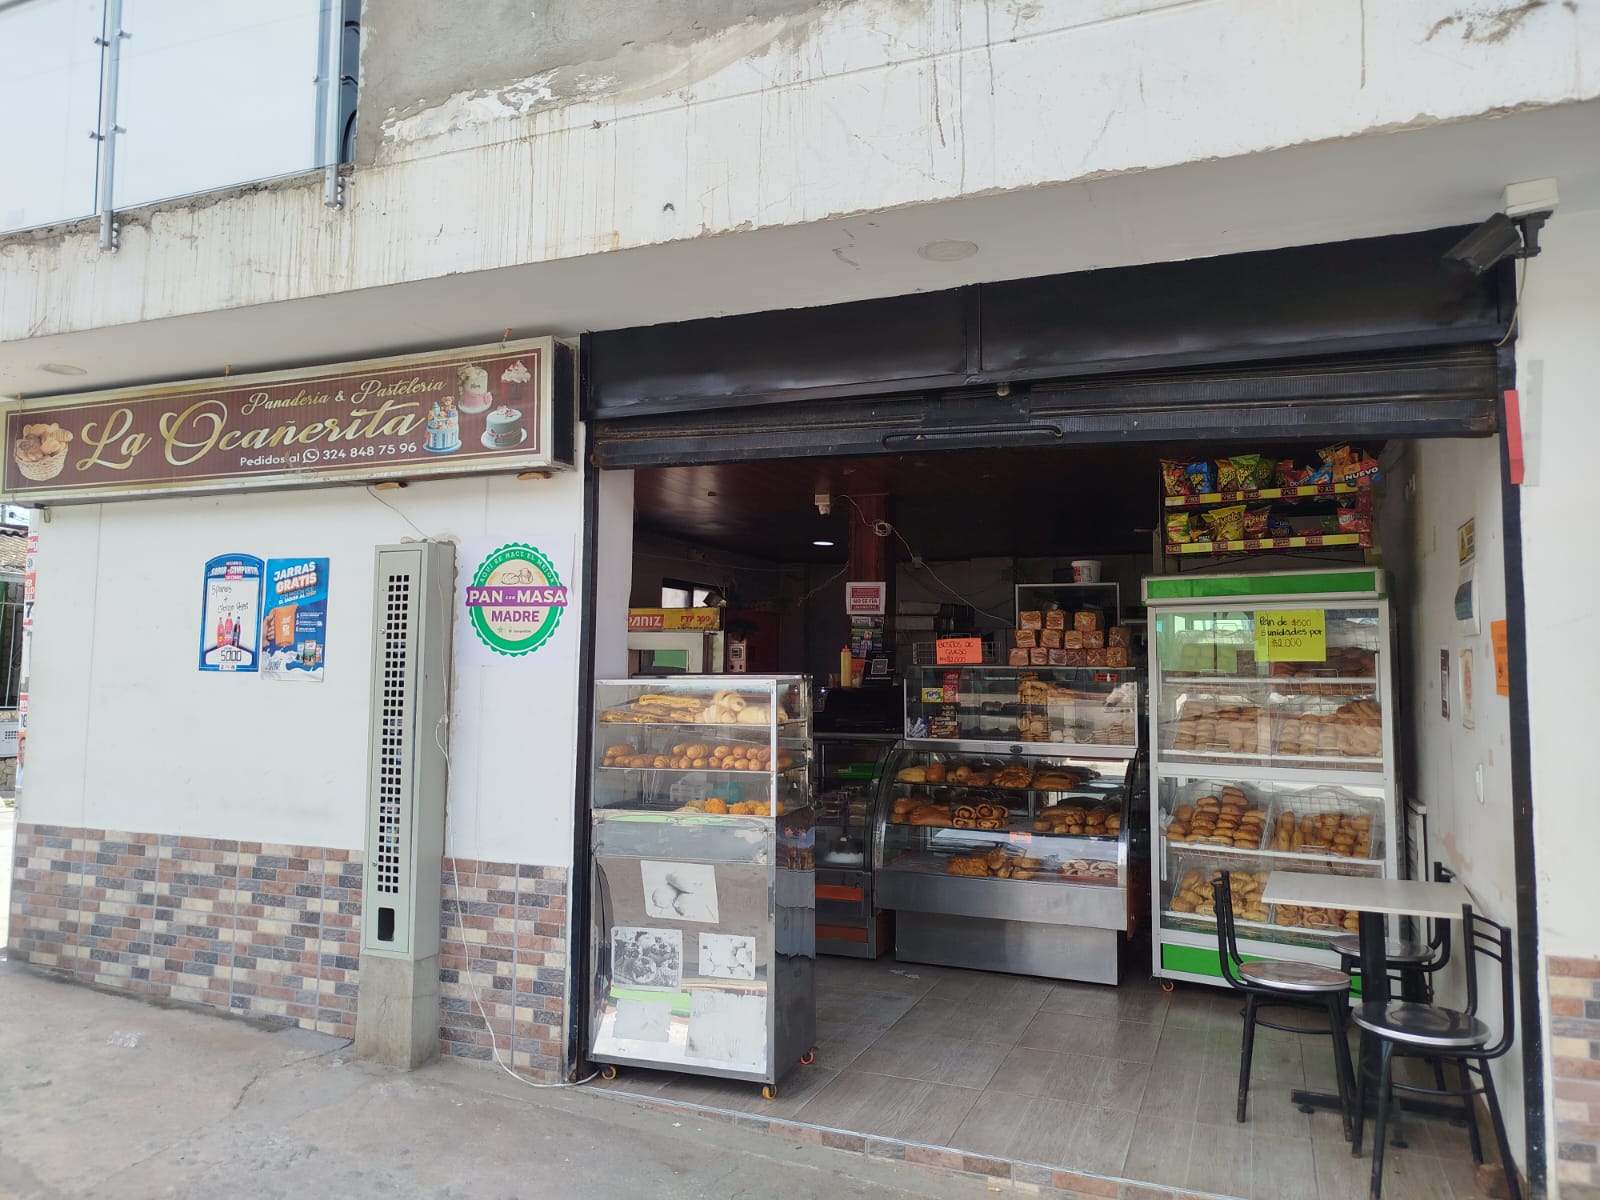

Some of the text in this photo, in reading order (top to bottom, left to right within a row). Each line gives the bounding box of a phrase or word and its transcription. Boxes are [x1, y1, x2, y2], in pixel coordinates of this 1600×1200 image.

[241, 376, 447, 416] Panaderia & Pasteleria
[75, 399, 425, 470] La Ocañerita
[240, 441, 417, 468] Pedidos al 324 848 75 96
[1345, 466, 1379, 482] NUEVO
[273, 561, 316, 582] JARRAS
[276, 572, 318, 595] GRATIS
[469, 590, 503, 603] PAN
[516, 590, 566, 603] MASA
[25, 601, 34, 619] 7
[491, 610, 540, 622] MADRE
[1259, 616, 1275, 626] Pan
[1277, 616, 1287, 626] de
[1309, 629, 1323, 638] por
[220, 650, 242, 662] 5000
